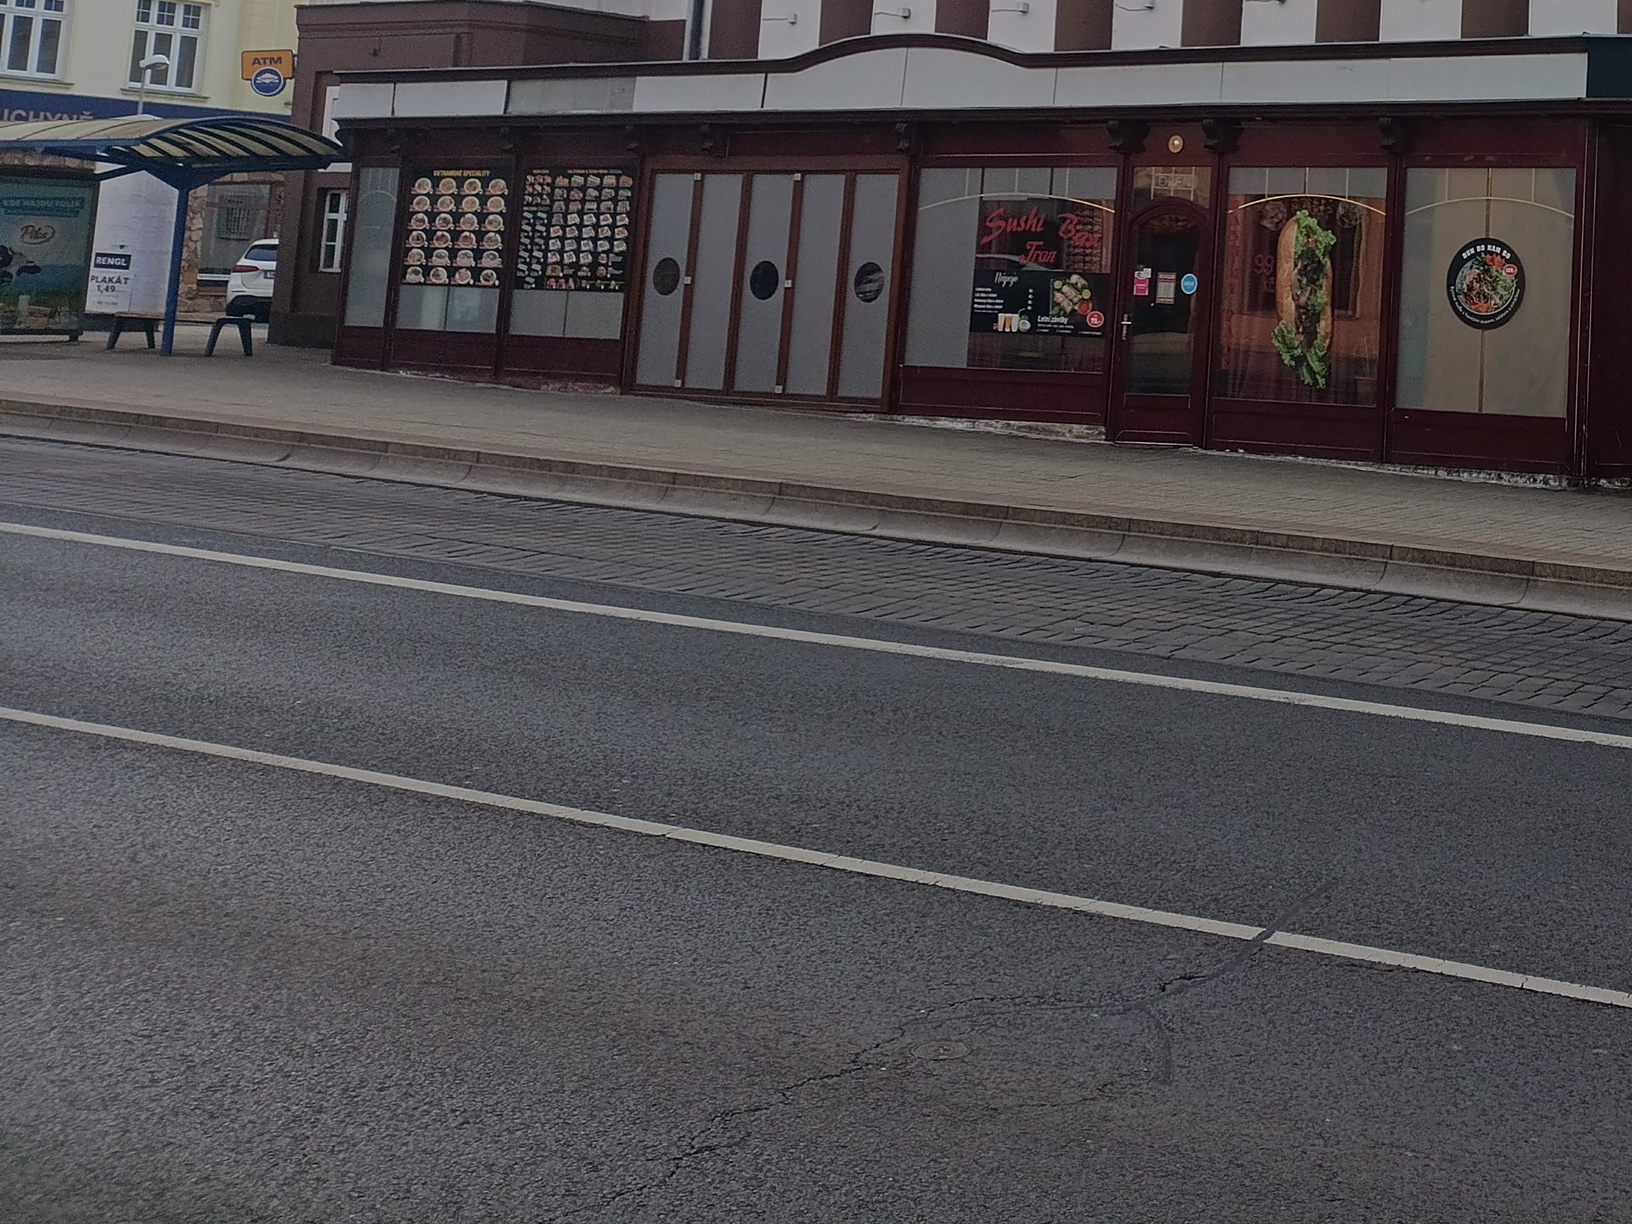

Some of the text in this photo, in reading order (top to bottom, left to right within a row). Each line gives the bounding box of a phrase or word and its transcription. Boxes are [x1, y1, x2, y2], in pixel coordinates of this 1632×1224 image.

[252, 56, 283, 66] ATM
[980, 207, 1045, 244] Sushi
[1020, 241, 1057, 265] Tran
[95, 256, 127, 266] RENGL
[1254, 253, 1274, 275] 99
[90, 275, 131, 285] PLAKÁT
[96, 285, 116, 294] 1,49
